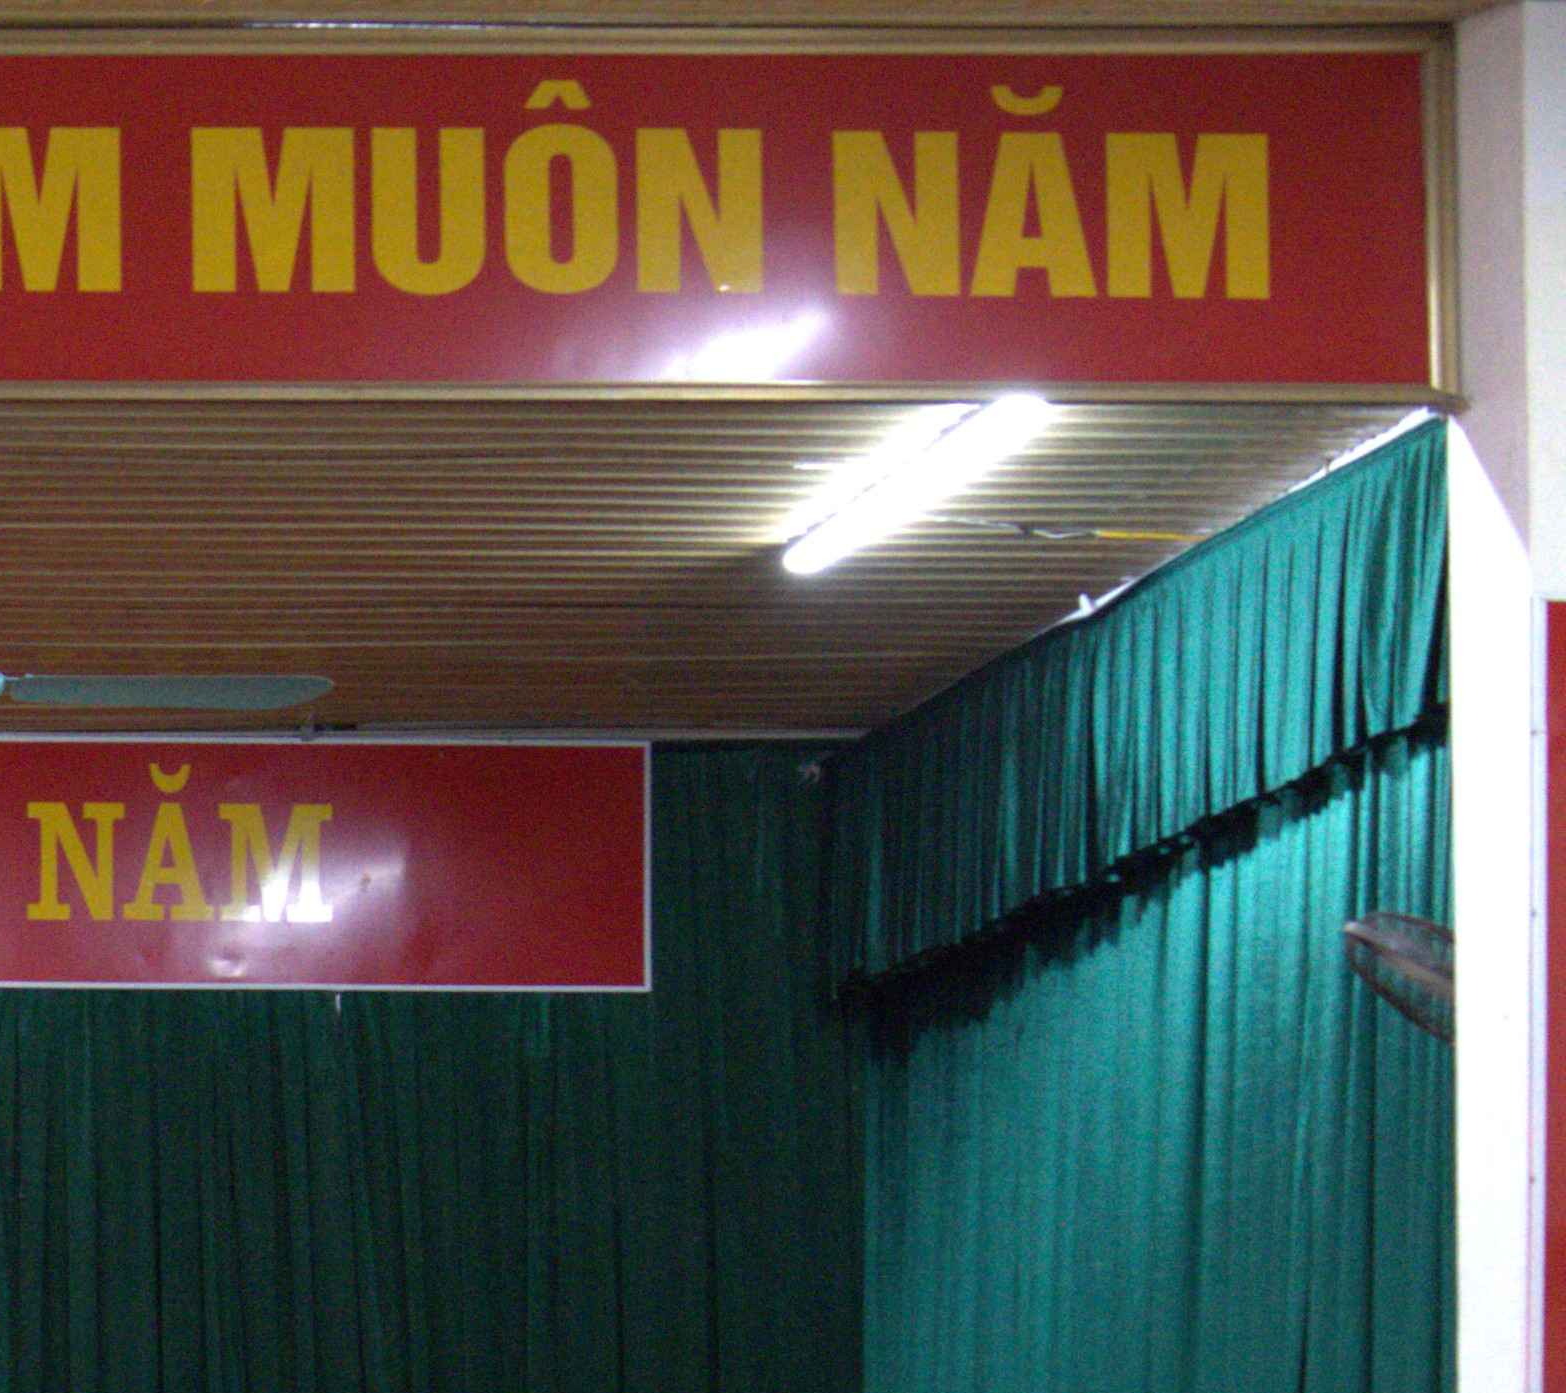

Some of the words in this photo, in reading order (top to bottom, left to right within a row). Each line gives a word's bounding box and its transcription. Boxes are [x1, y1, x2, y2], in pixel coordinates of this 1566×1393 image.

[189, 79, 765, 296] MUÔN
[831, 86, 1271, 300] NĂM
[25, 764, 334, 923] NĂM
